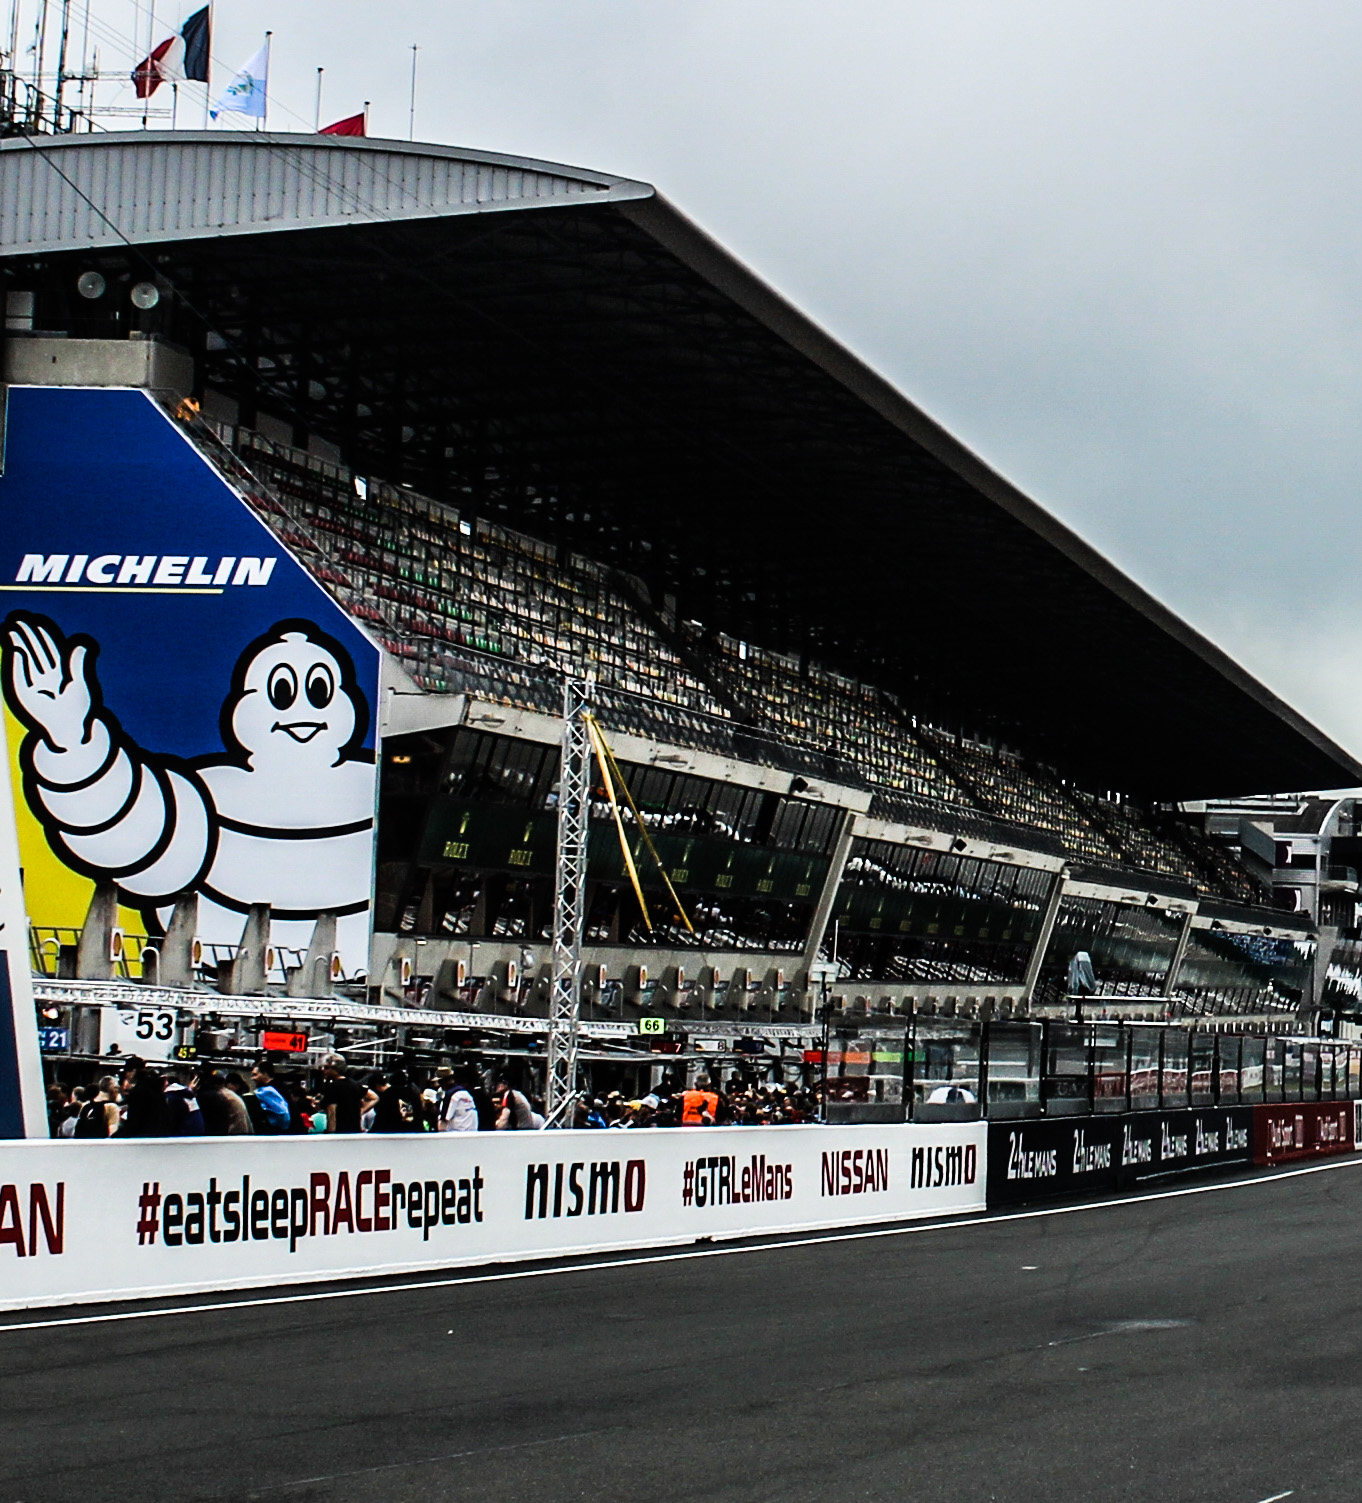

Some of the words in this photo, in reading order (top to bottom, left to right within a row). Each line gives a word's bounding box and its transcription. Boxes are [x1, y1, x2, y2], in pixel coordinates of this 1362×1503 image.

[15, 554, 277, 586] MICHELIN
[136, 1012, 173, 1040] 53
[645, 1020, 660, 1031] 66
[49, 1031, 67, 1048] 21
[675, 1043, 682, 1053] 7
[136, 1165, 484, 1253] #eatsleepRACErepeat
[524, 1159, 646, 1221] nismo
[682, 1154, 793, 1207] #GTRLeMans
[821, 1149, 889, 1197] NISSAN
[910, 1143, 977, 1190] nismo
